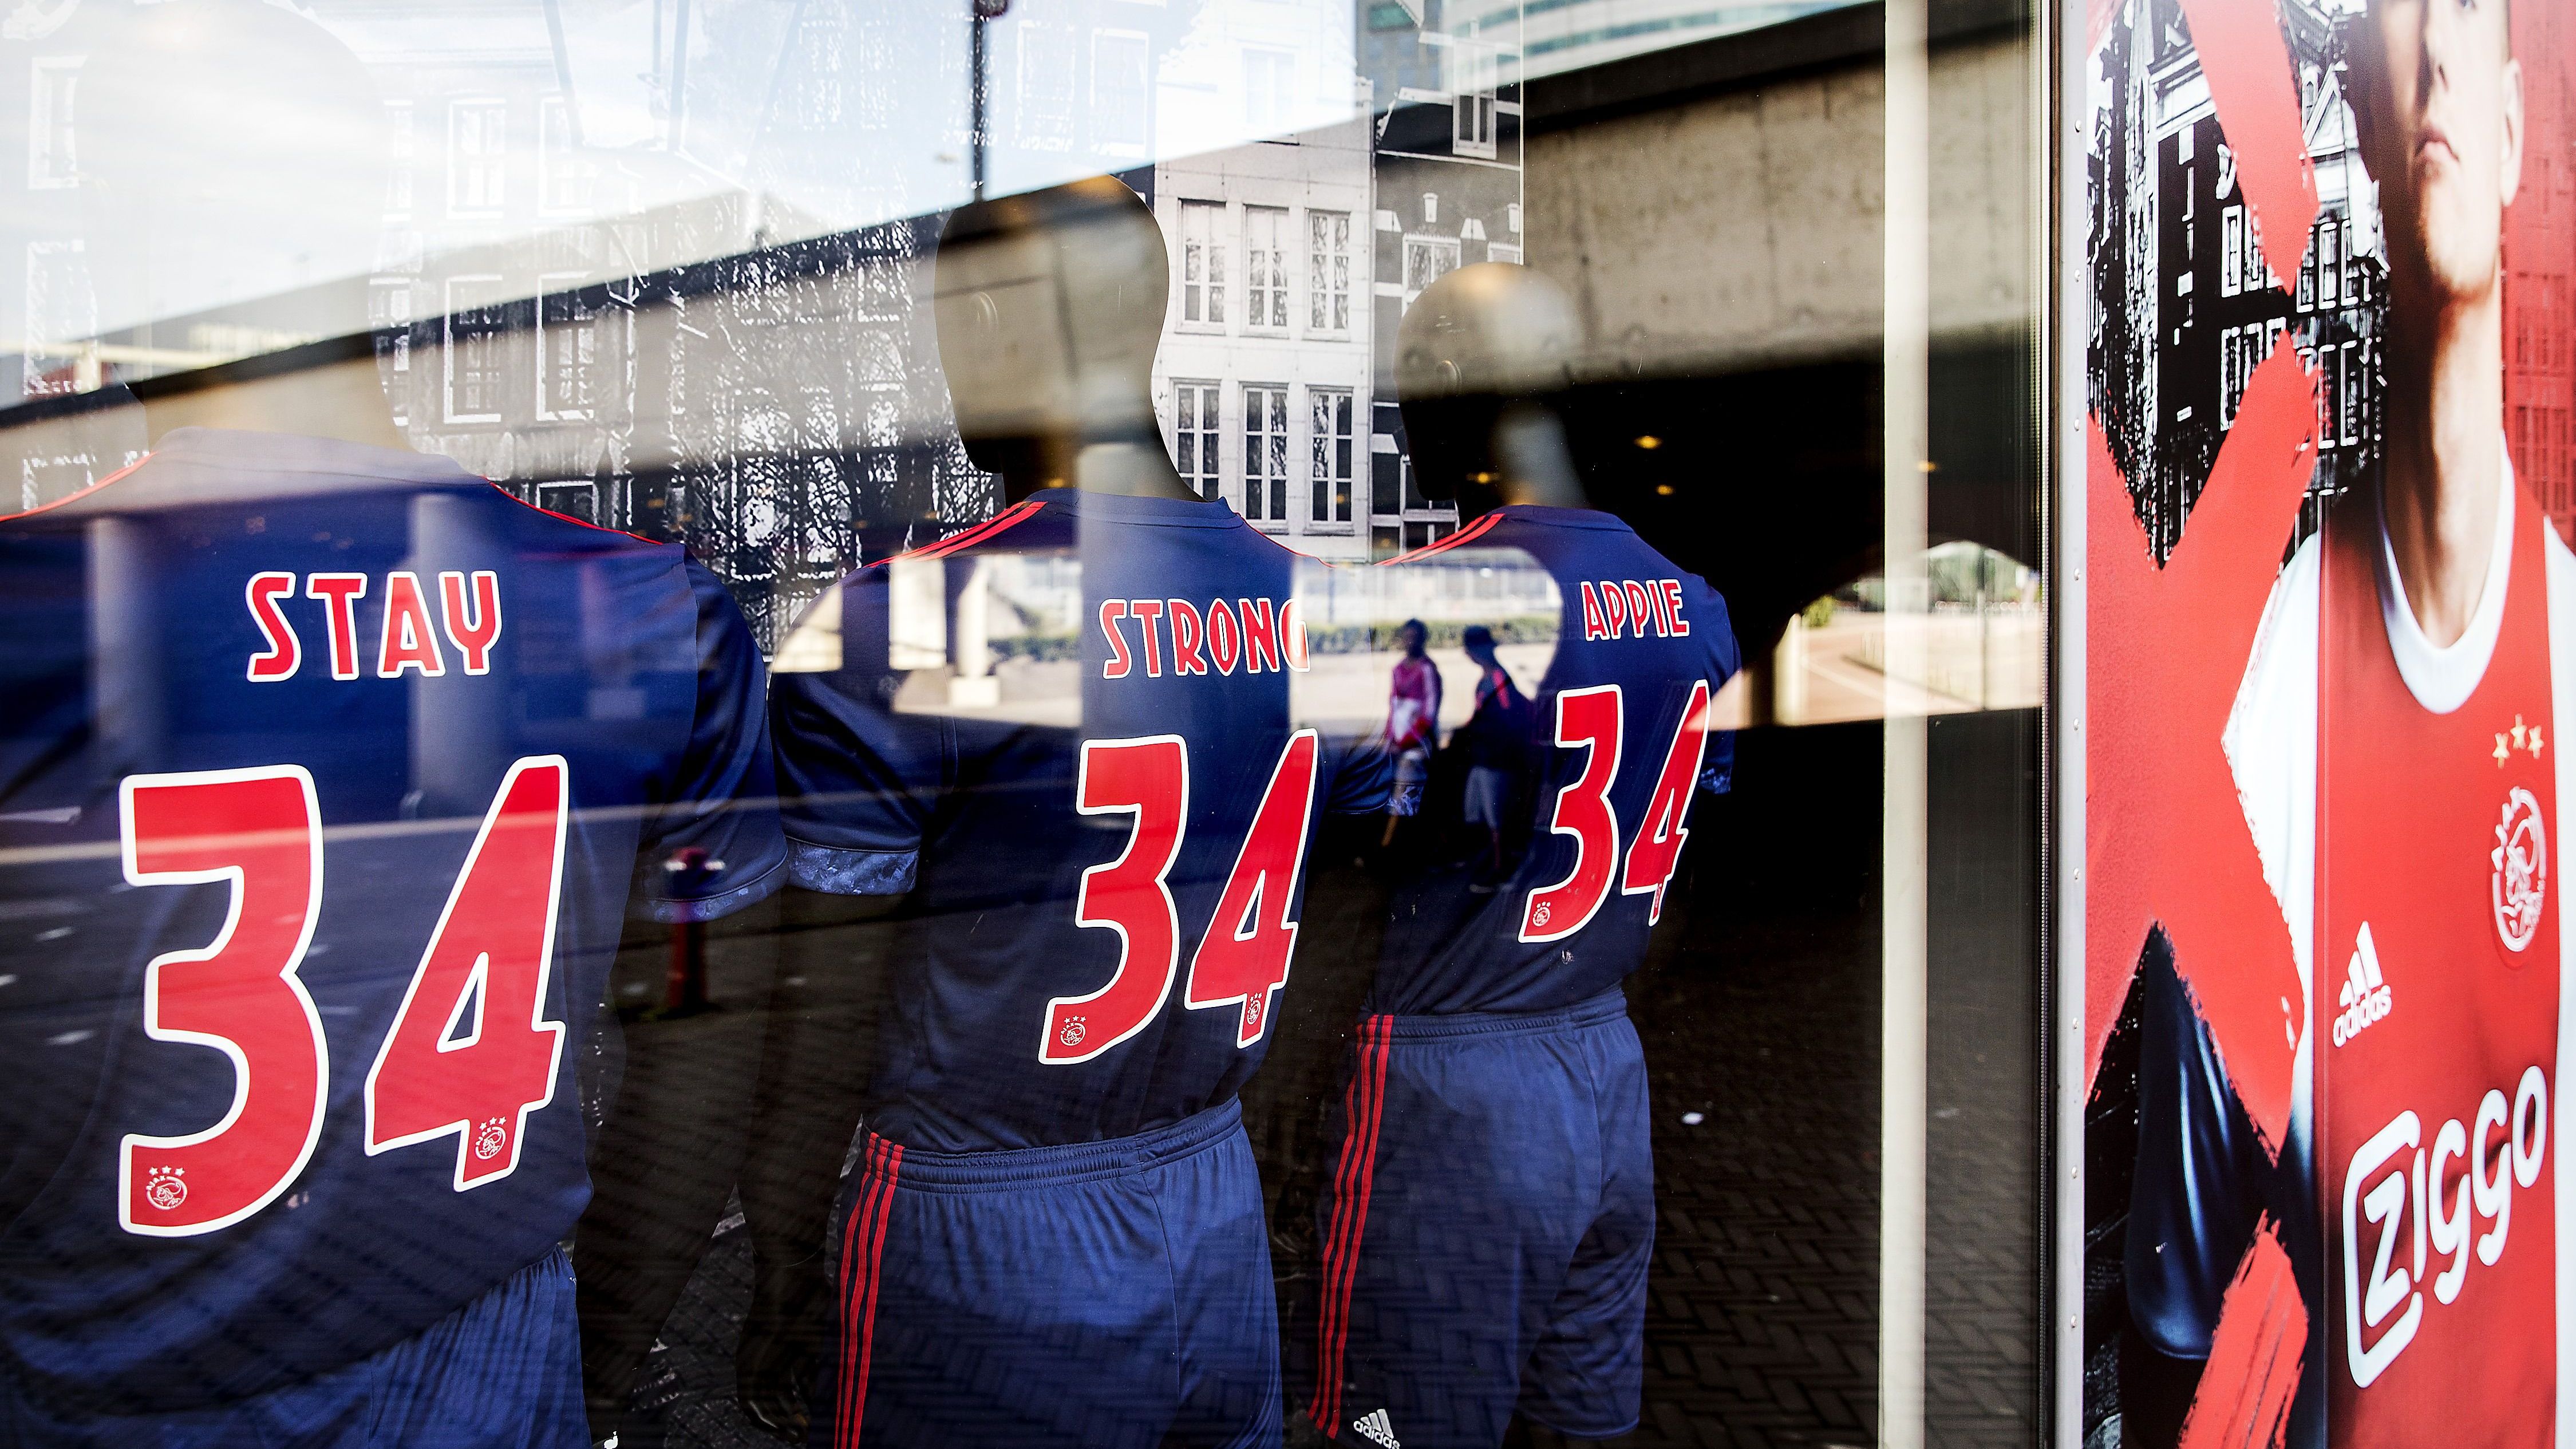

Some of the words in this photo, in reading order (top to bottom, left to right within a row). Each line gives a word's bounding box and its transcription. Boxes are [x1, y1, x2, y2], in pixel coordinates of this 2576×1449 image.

[246, 571, 502, 682] STAY
[1099, 598, 1310, 679] STRONG
[1581, 579, 1689, 641] APPIE
[1518, 680, 1711, 943] 34
[1038, 728, 1318, 1064] 34
[118, 755, 568, 1237] 34
[2333, 984, 2392, 1047] adidas
[1353, 1420, 1401, 1449] adidas
